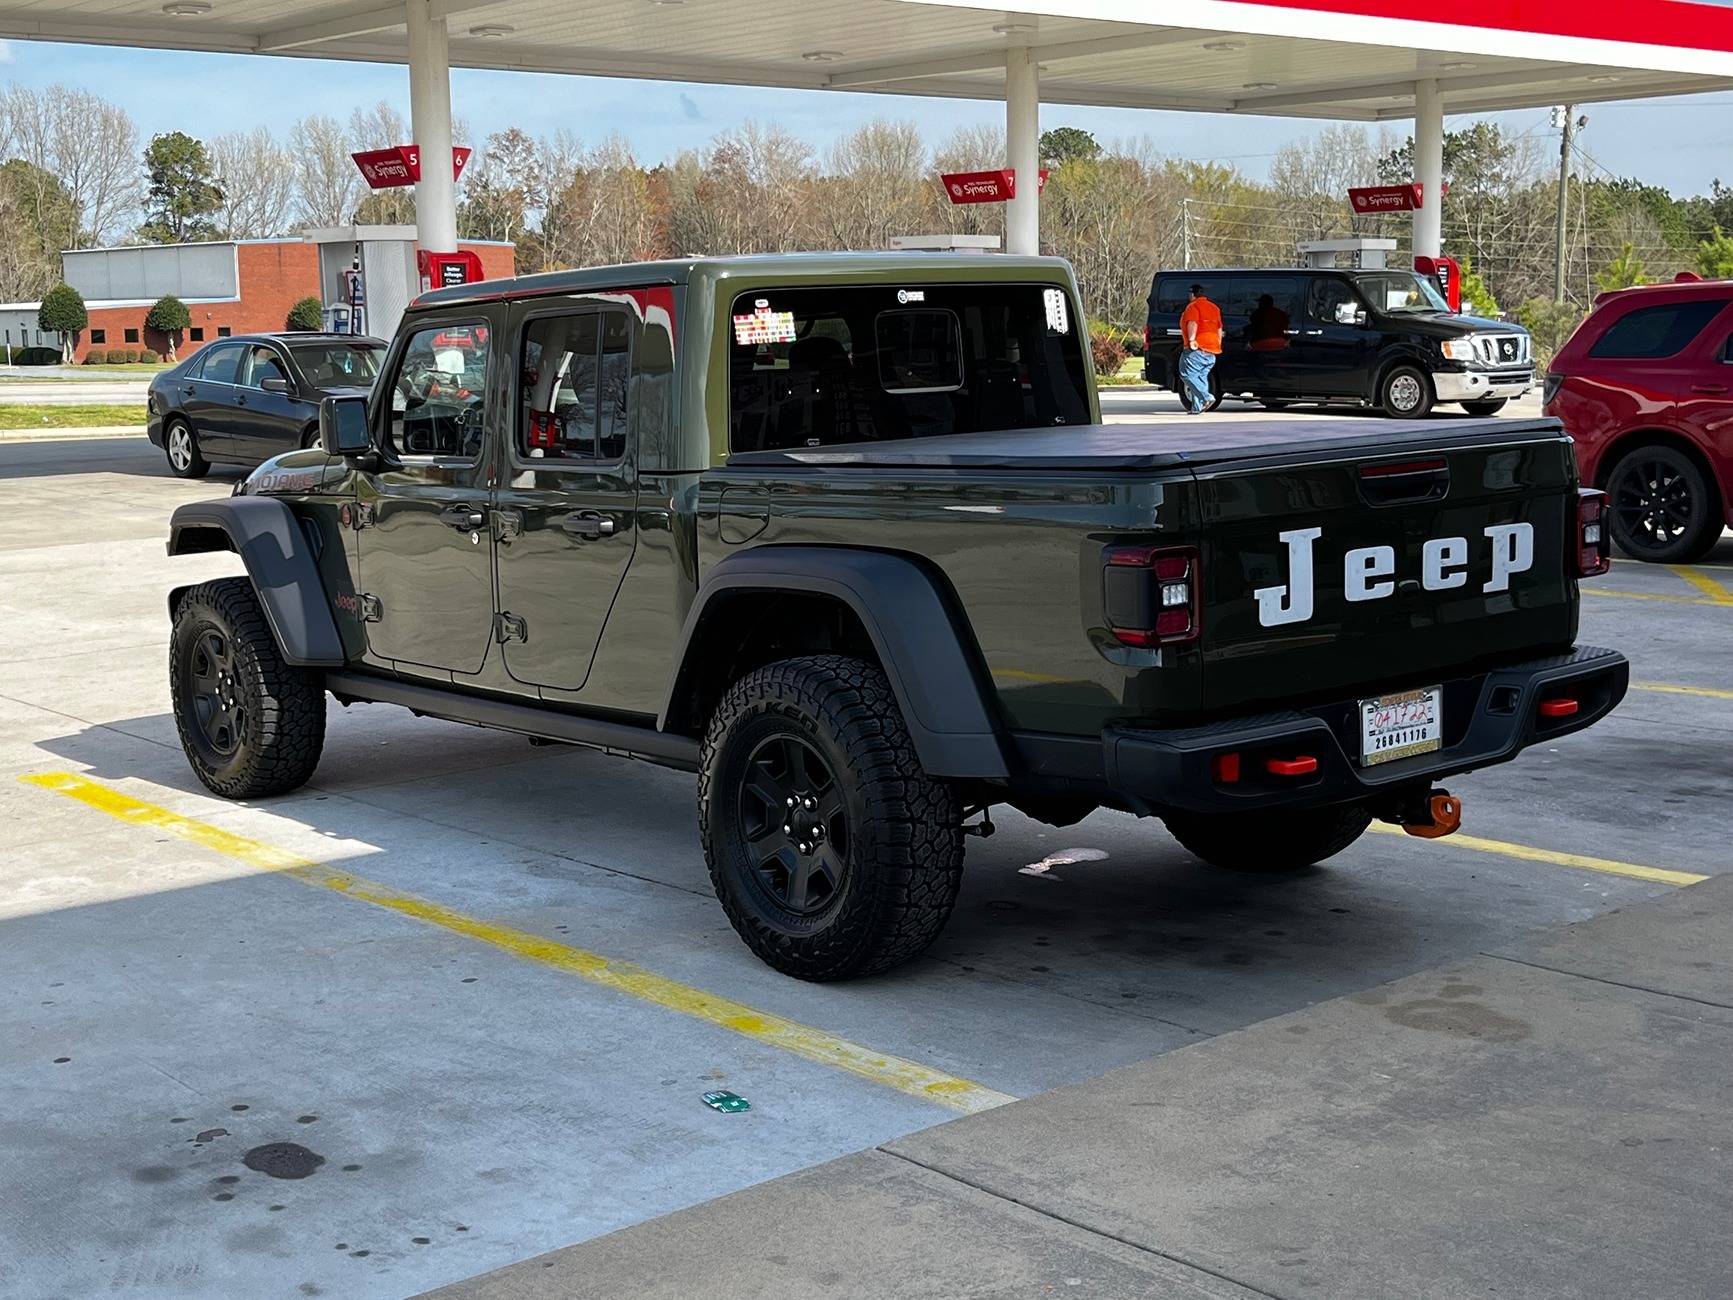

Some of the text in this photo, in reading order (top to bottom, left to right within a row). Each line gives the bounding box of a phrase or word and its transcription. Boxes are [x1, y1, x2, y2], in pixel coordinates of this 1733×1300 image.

[409, 153, 417, 165] 5
[455, 155, 463, 166] 6
[374, 164, 408, 178] Synergy
[1008, 177, 1014, 186] 7
[963, 184, 998, 196] Synergy
[1368, 195, 1404, 206] Synergy
[1254, 526, 1534, 627] Jeep
[1375, 728, 1427, 749] 26841176
